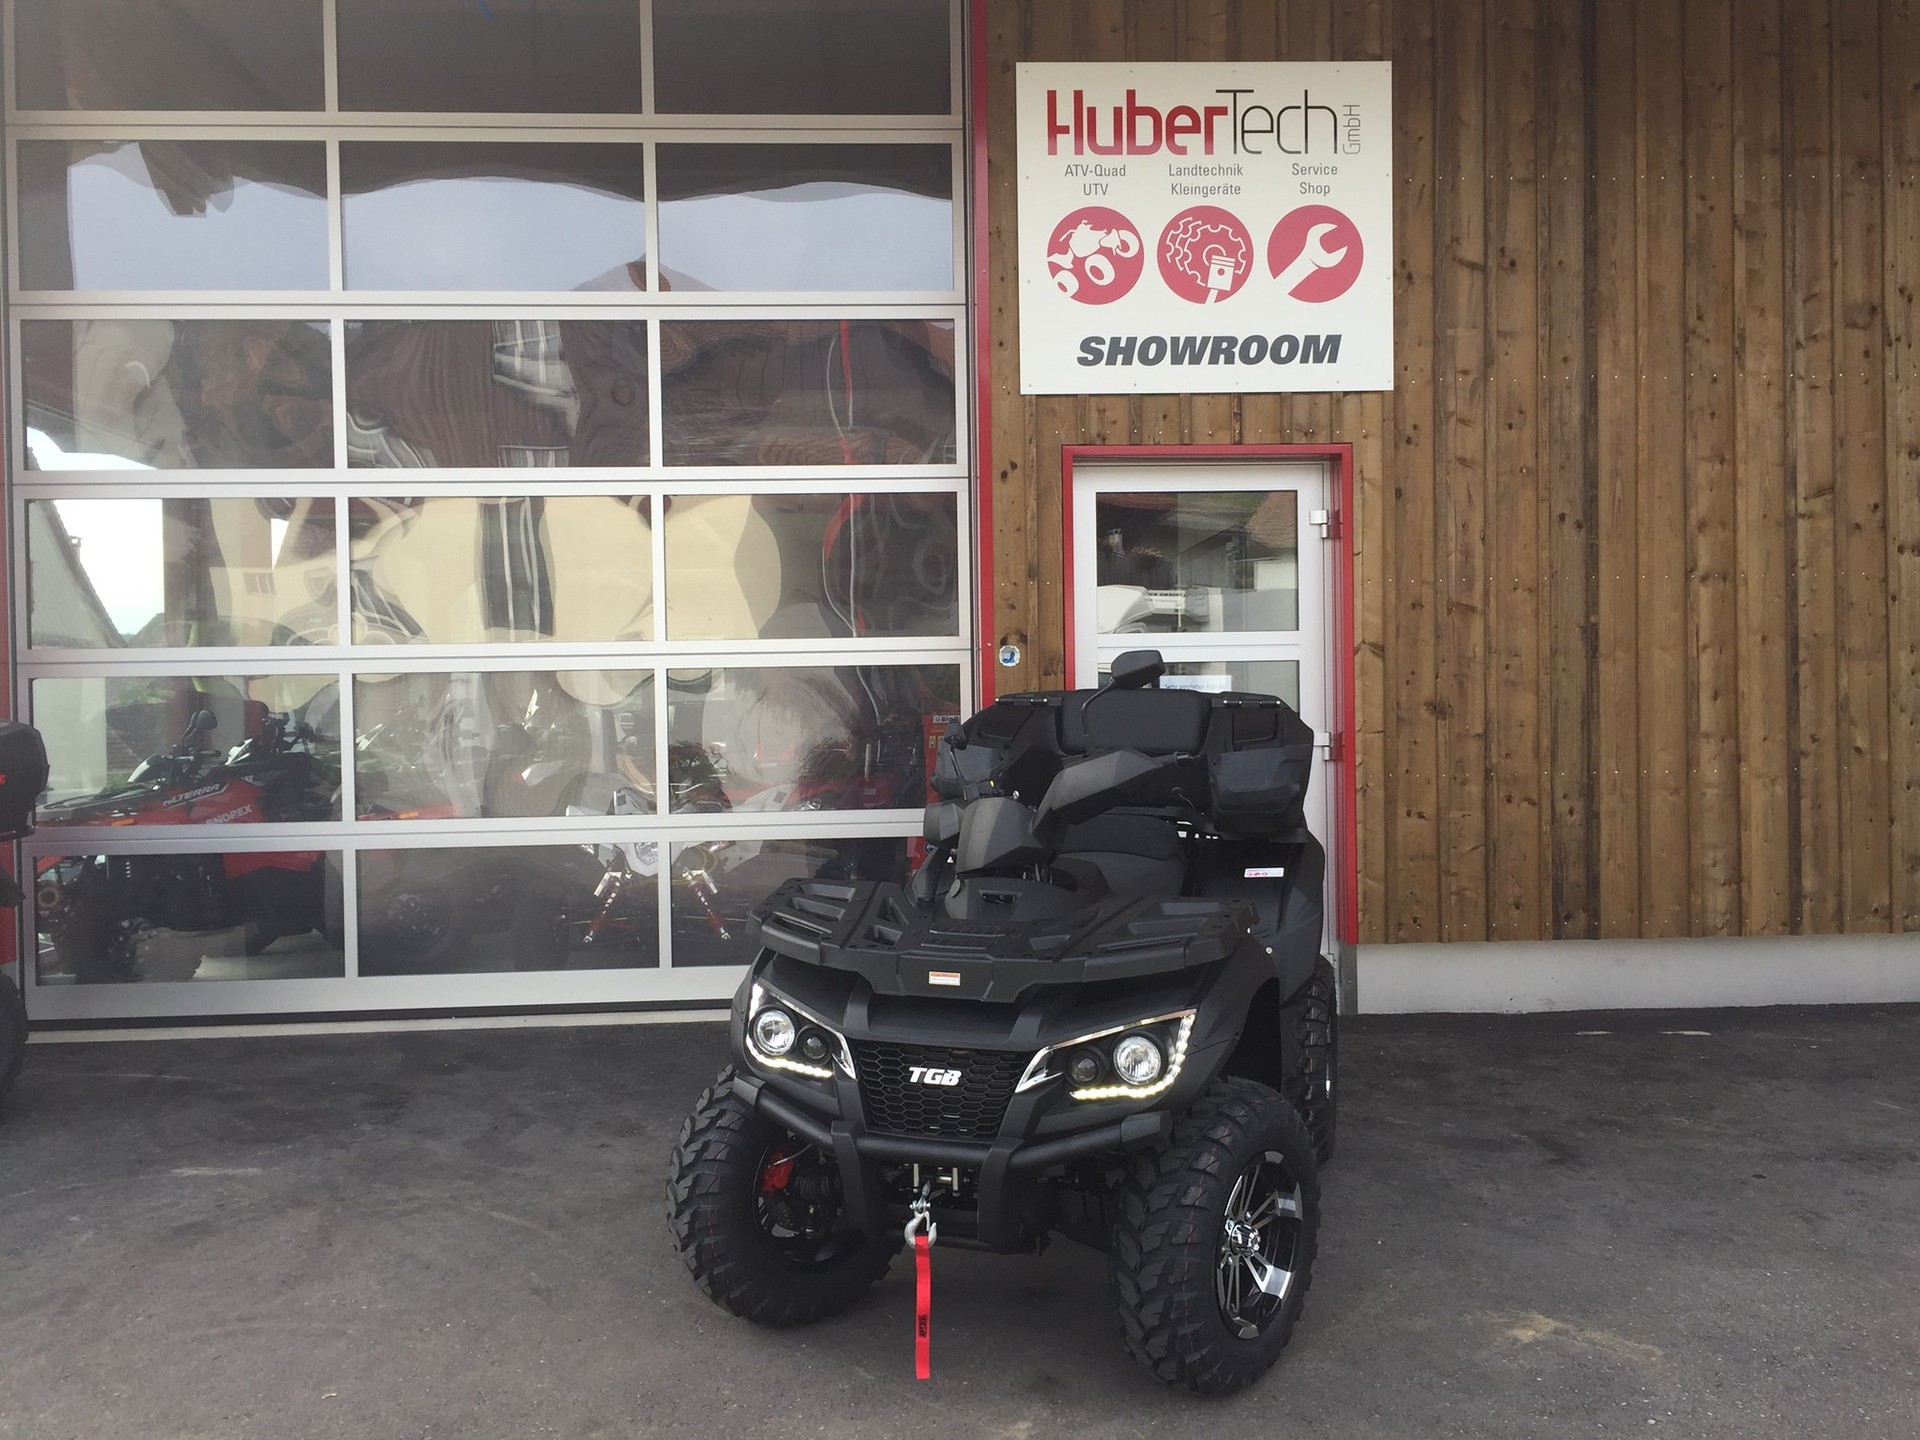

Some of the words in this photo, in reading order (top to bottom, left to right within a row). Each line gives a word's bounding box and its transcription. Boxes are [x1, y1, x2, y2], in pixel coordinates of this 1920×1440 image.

[1047, 89, 1337, 155] HuberTech
[1342, 104, 1361, 155] GmbH
[1065, 163, 1126, 177] ATV-Quad
[1168, 163, 1243, 177] Landtechnik
[1291, 162, 1338, 176] Service
[1083, 183, 1109, 196] UTV
[1171, 182, 1241, 198] Kleingeräte
[1299, 181, 1331, 197] Shop
[1076, 334, 1342, 367] SHOWROOM
[909, 1066, 962, 1087] TGB
